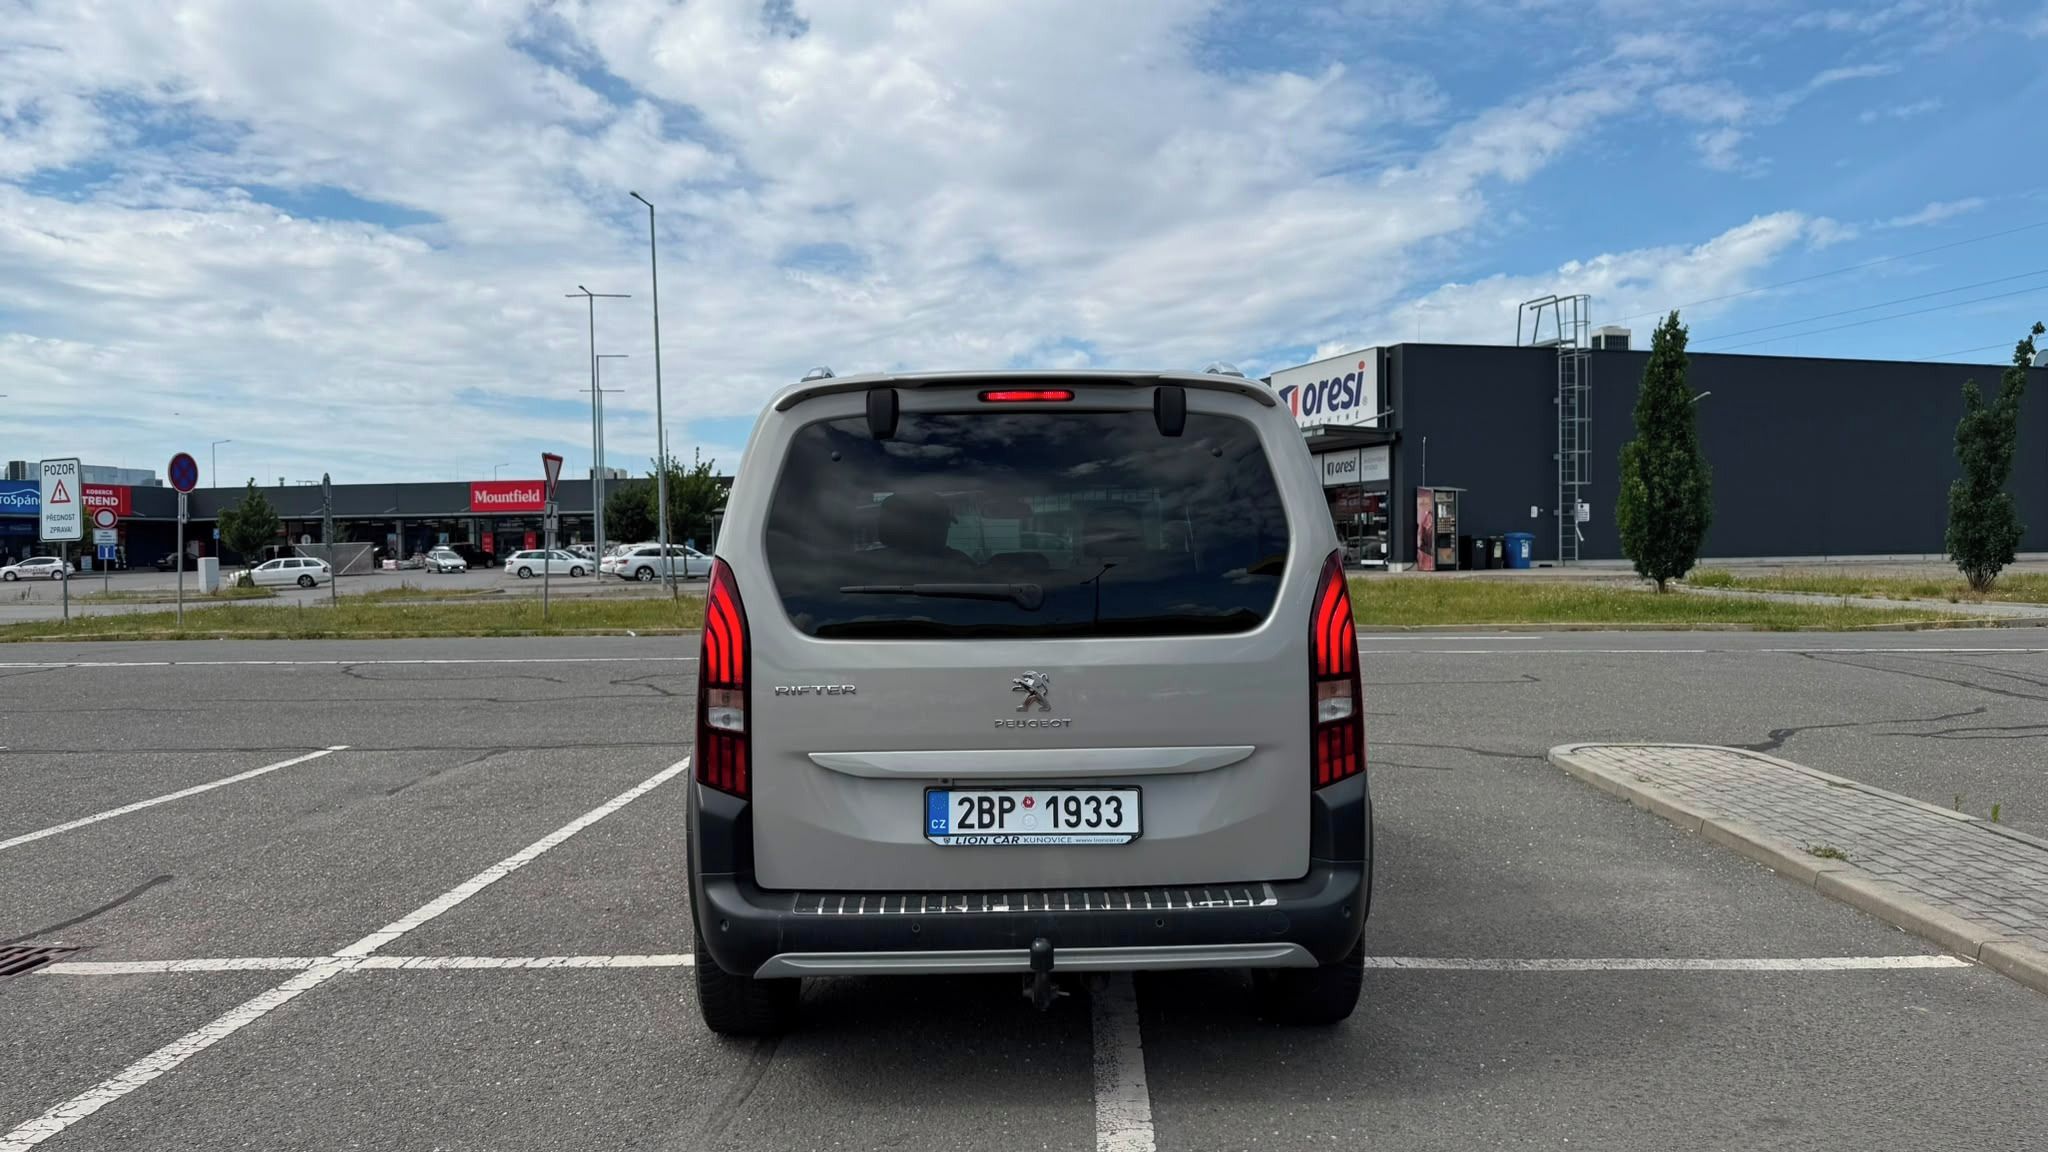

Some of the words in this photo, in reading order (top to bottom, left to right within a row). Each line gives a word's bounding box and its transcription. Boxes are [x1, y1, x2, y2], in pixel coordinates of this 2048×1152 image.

[1302, 361, 1365, 416] oresi
[44, 463, 75, 476] POZOR
[1335, 457, 1356, 474] oresi
[0, 494, 40, 507] roSpán
[82, 495, 119, 506] TREND
[474, 488, 540, 503] Mountfield
[774, 684, 857, 696] RIFTER
[994, 718, 1072, 729] PEUGEOT
[957, 795, 1016, 829] 2BP
[1045, 795, 1124, 829] 1933
[931, 819, 946, 829] CZ
[955, 836, 989, 844] LION
[992, 836, 1020, 844] CAR
[1023, 836, 1073, 844] KUNOVICE
